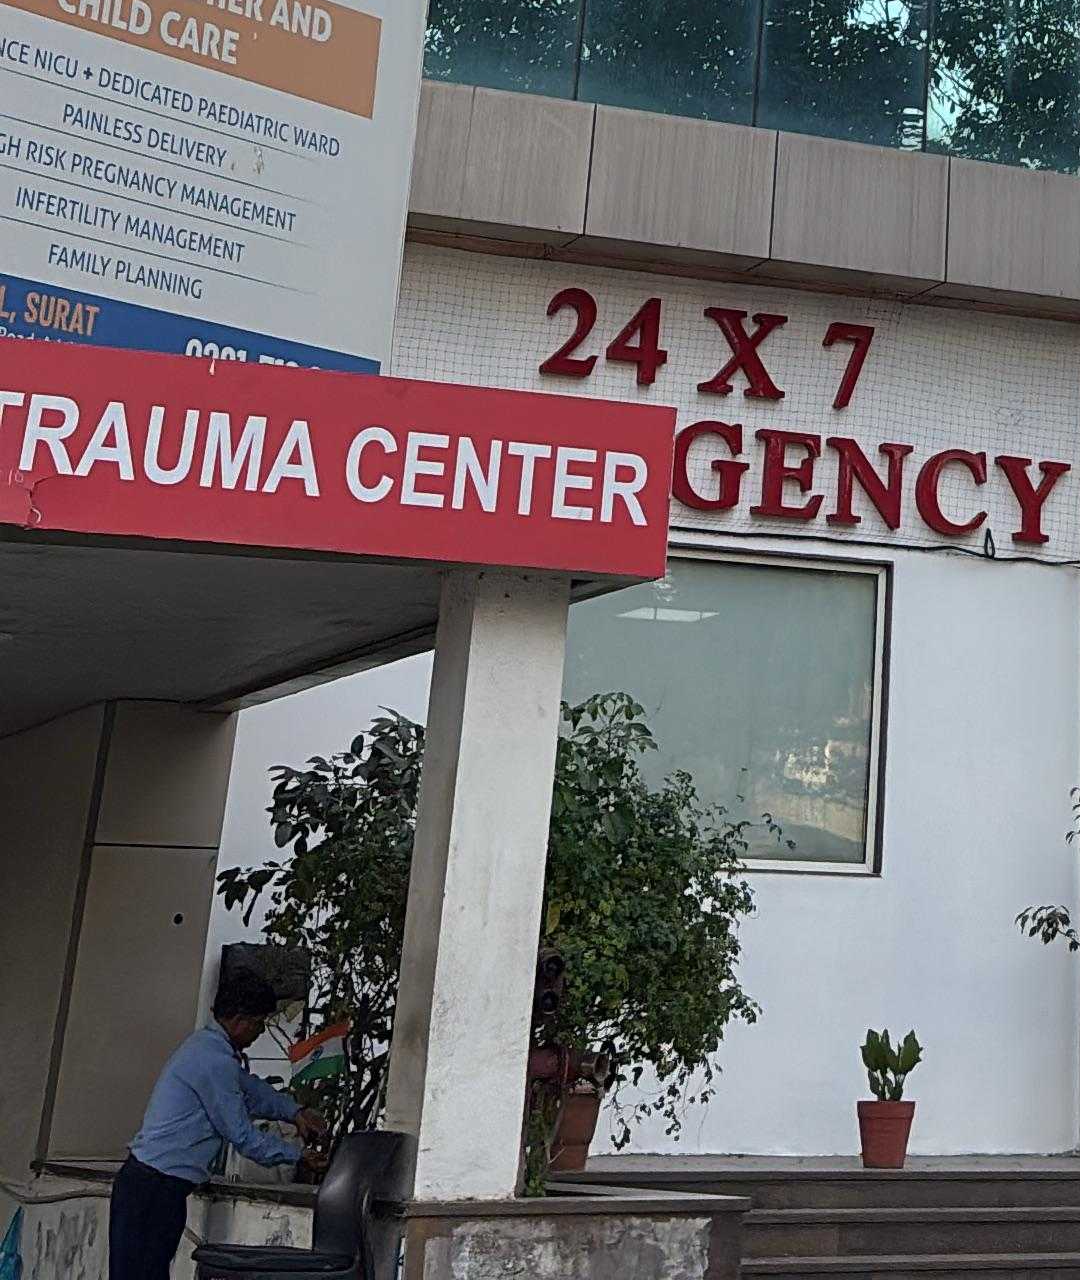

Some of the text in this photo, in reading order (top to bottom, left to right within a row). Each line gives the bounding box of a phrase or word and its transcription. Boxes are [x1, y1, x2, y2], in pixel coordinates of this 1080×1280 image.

[160, 11, 240, 65] CARE
[34, 48, 79, 79] NICU
[98, 67, 193, 113] DEDICATED
[198, 97, 290, 143] PAEDIATRIC
[294, 125, 341, 157] WARD
[63, 103, 227, 168] PAINLESS DELIVERY
[15, 186, 246, 263] INFERTILITY MANAGEMENT
[26, 140, 67, 170] RISK
[70, 152, 177, 199] PREGNANCY
[180, 183, 297, 232] MANAGEMENT
[48, 243, 203, 300] FAMILY PLANNING
[24, 291, 100, 336] SURAT
[539, 287, 875, 410] 24 X 7
[0, 391, 648, 526] TRAUMA CENTER
